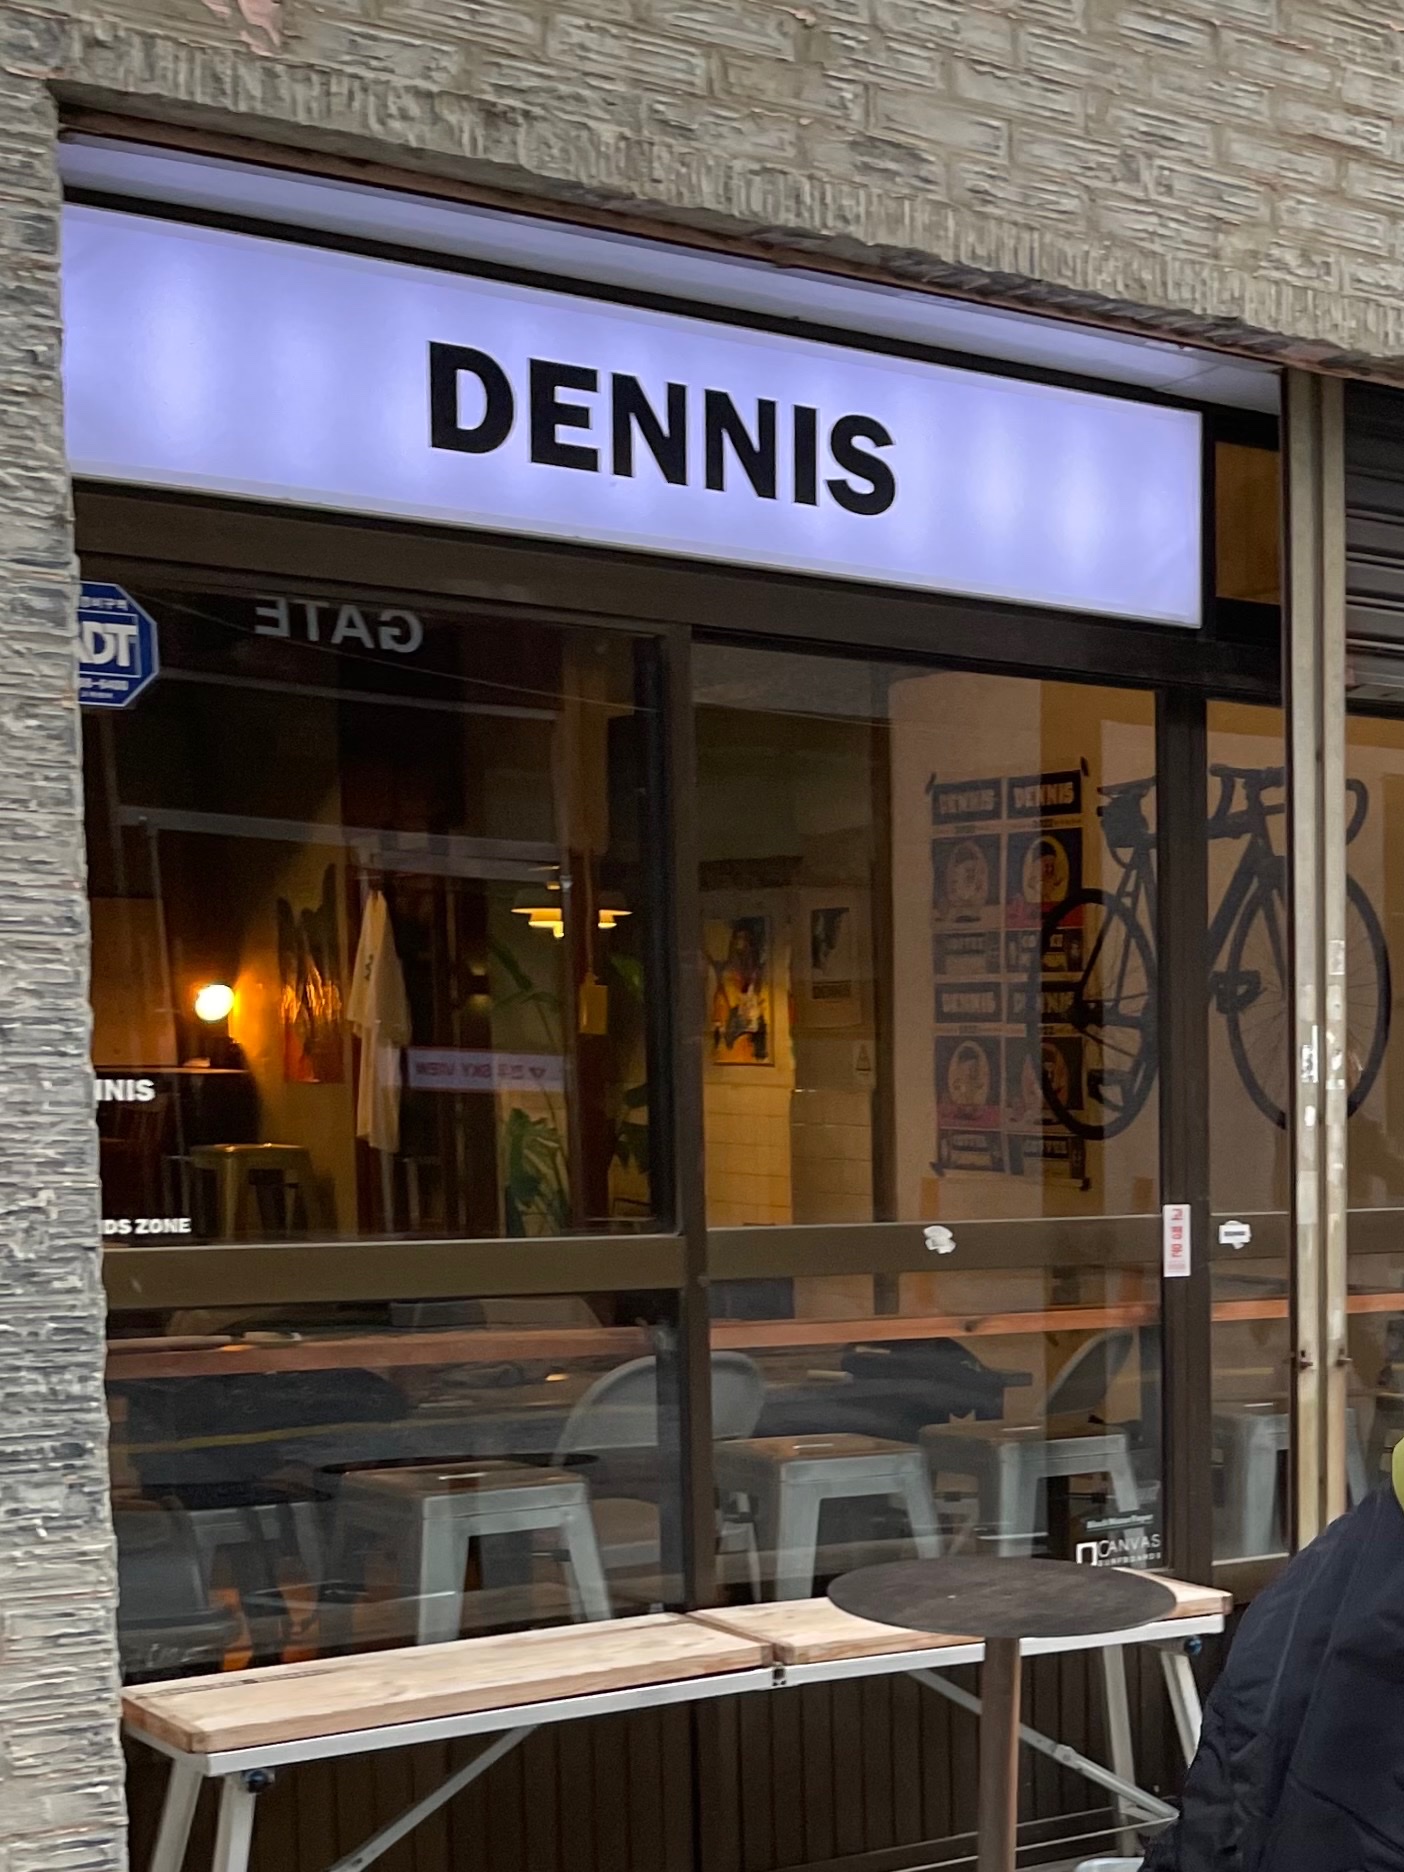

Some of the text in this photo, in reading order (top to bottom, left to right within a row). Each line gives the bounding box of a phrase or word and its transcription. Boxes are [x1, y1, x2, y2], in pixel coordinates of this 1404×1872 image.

[428, 340, 897, 516] DENNIS
[1012, 781, 1074, 809] DENNIS
[134, 1217, 192, 1234] ZONE
[1098, 1533, 1161, 1558] CANVAS
